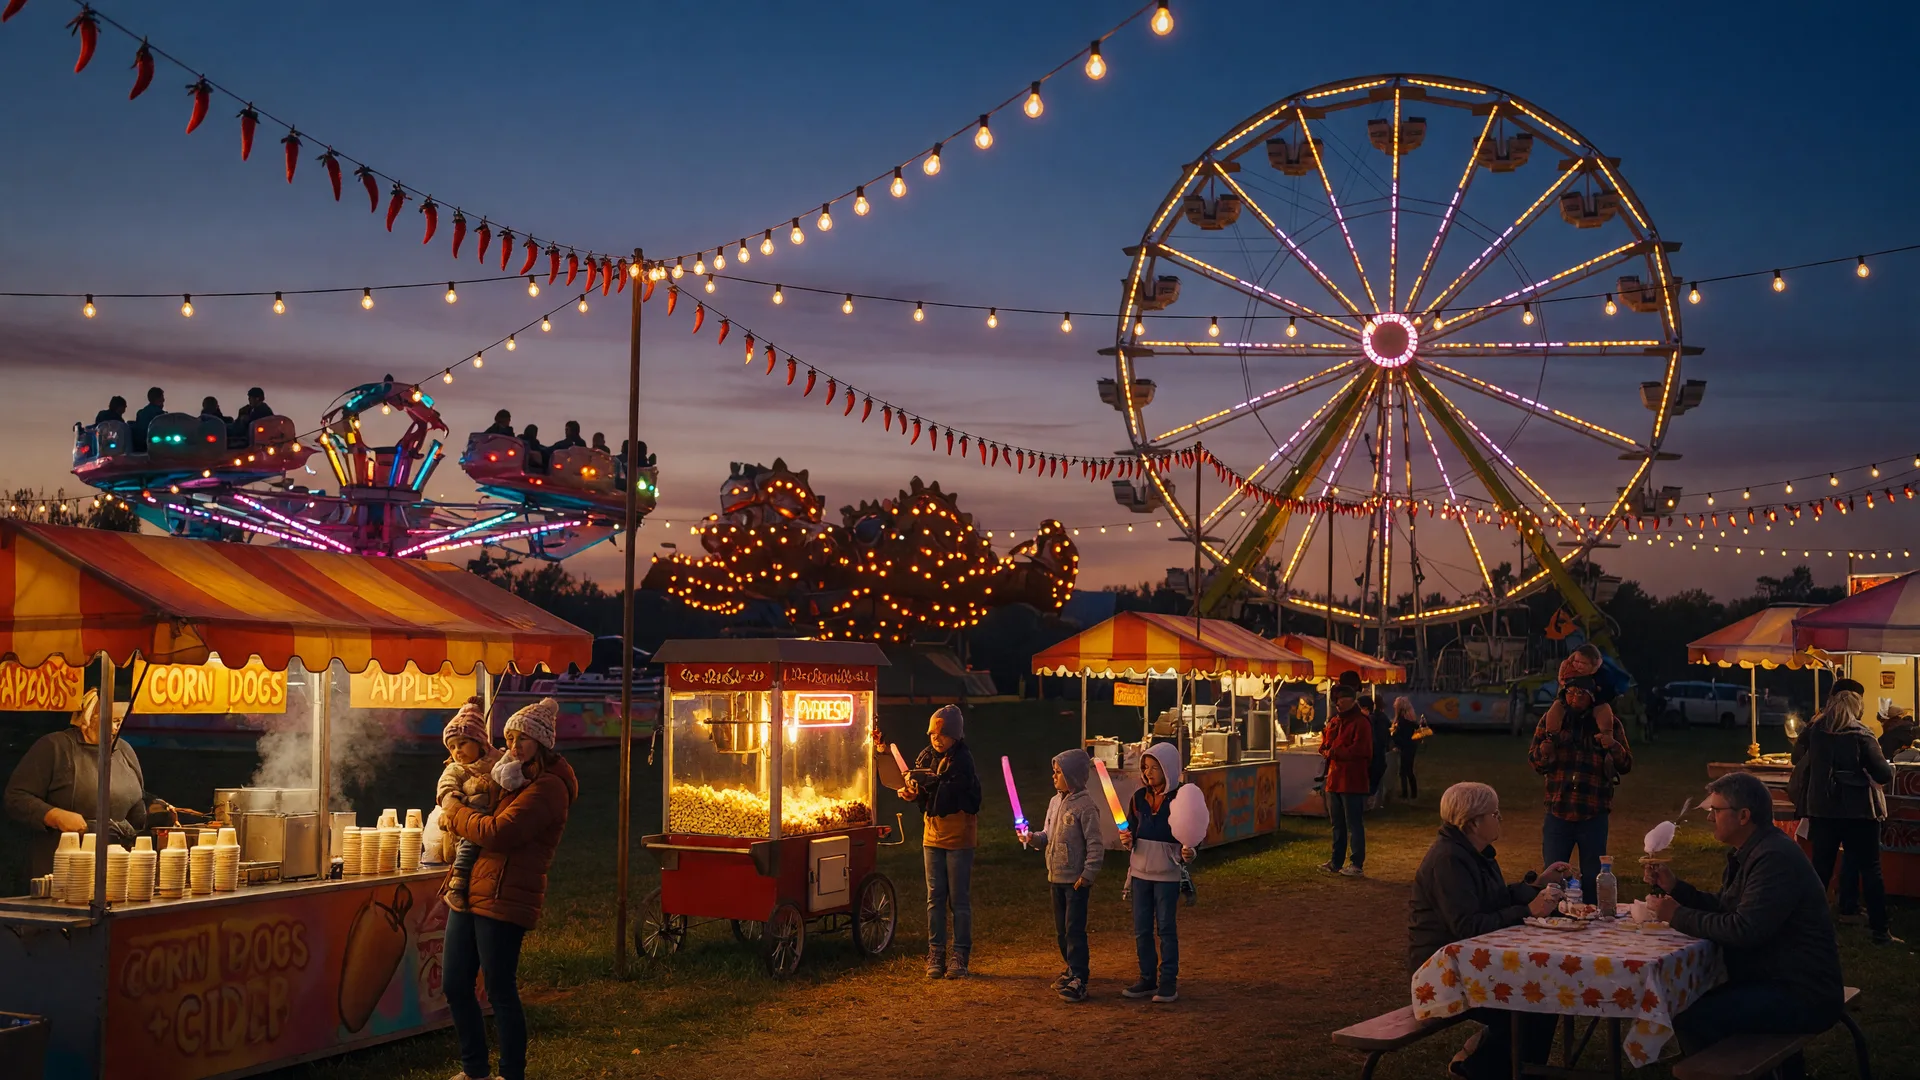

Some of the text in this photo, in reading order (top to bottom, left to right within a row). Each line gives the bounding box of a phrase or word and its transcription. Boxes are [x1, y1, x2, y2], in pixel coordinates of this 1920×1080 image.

[150, 667, 283, 705] CORN DOGS
[370, 671, 453, 703] APPLES
